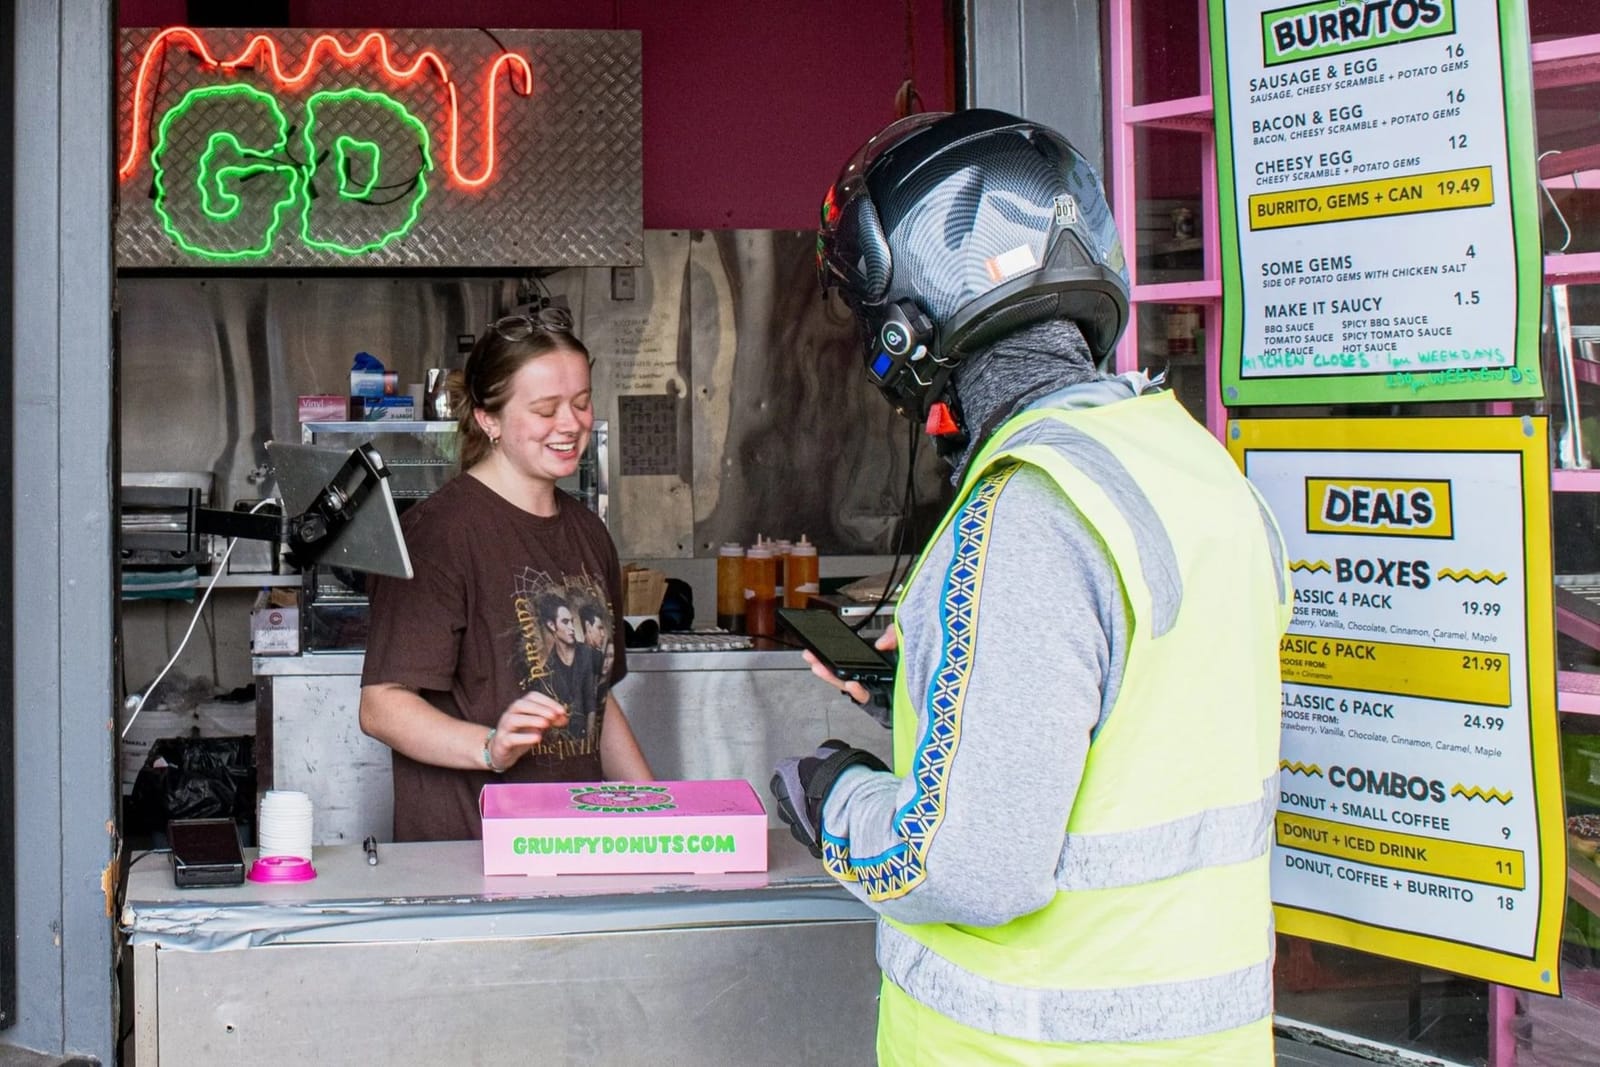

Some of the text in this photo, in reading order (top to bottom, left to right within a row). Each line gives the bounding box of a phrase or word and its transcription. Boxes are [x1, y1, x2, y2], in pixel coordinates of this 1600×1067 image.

[1273, 0, 1442, 52] BURRITOS
[1250, 43, 1465, 92] SAUSAGE & EGG 16
[1250, 89, 1294, 103] SAUSAGE,
[1296, 83, 1331, 97] CHEESY
[1335, 74, 1385, 91] SCRAMBLE
[1397, 65, 1438, 80] POTATO
[1440, 60, 1470, 74] GEMS
[1252, 89, 1466, 134] BACON & EGG 16
[1253, 132, 1288, 146] BACON,
[1290, 126, 1324, 140] CHEESY
[1328, 119, 1378, 136] SCRAMBLE
[1391, 112, 1429, 126] POTATO
[1433, 107, 1461, 121] GEMS
[1255, 134, 1468, 175] CHEESY EGG 12
[1256, 173, 1289, 187] CHEESY
[1292, 167, 1341, 183] SCRAMBLE
[1352, 160, 1390, 175] POTATO
[1393, 156, 1421, 170] GEMS
[1257, 177, 1480, 218] BURRITO, GEMS + CAN 19.49
[1261, 244, 1476, 277] SOME GEMS 4
[1262, 262, 1467, 289] SIDE OF POTATO GEMS WITH CHICKEN SALT
[1264, 290, 1480, 318] MAKE IT SAUCY 1.5
[1264, 321, 1315, 334] BBQ SAUCE
[1341, 315, 1428, 330] SPICY BBQ SAUCE
[1341, 325, 1453, 342] SPICY TOMATO SAUCE
[1264, 332, 1334, 345] TOMATO SAUCE
[1264, 346, 1314, 357] HOT SAUCE
[1342, 342, 1397, 354] HOT SAUCE
[1418, 348, 1505, 363] WEEKDAYS
[1431, 366, 1537, 385] WEEKENDS
[302, 400, 324, 409] Vinyl
[1325, 489, 1433, 525] DEALS
[1335, 557, 1431, 590] BOXES
[1292, 606, 1339, 618] OSE FROM:
[1293, 589, 1501, 617] ASSIC 4 PACK 19.99
[1319, 619, 1345, 630] Vanilla,
[1347, 620, 1388, 634] Chocolate,
[1390, 624, 1432, 638] Cinnamon,
[1433, 629, 1469, 642] Caramel,
[1471, 632, 1498, 644] Maple
[1280, 658, 1326, 669] HOOSE FROM:
[1321, 642, 1331, 656] 6
[1335, 643, 1376, 661] PACK
[1462, 655, 1502, 672] 21.99
[1301, 670, 1333, 680] Cinnamon
[1281, 692, 1504, 731] LASSIC 6 PACK 24.99
[1281, 710, 1339, 724] HOOSE FROM:
[1280, 721, 1502, 759] trawberry, Vanilla, Chocolate, Cinnamon, Caramel, Maple
[1328, 765, 1446, 803] COMBOS
[1280, 791, 1511, 840] DONUT + SMALL COFFEE 9
[513, 834, 736, 855] GRUMPYDONUTS.COM
[1283, 823, 1512, 876] DONUT + ICED DRINK 11
[1285, 854, 1514, 911] DONUT, COFFEE + BURRITO 18
